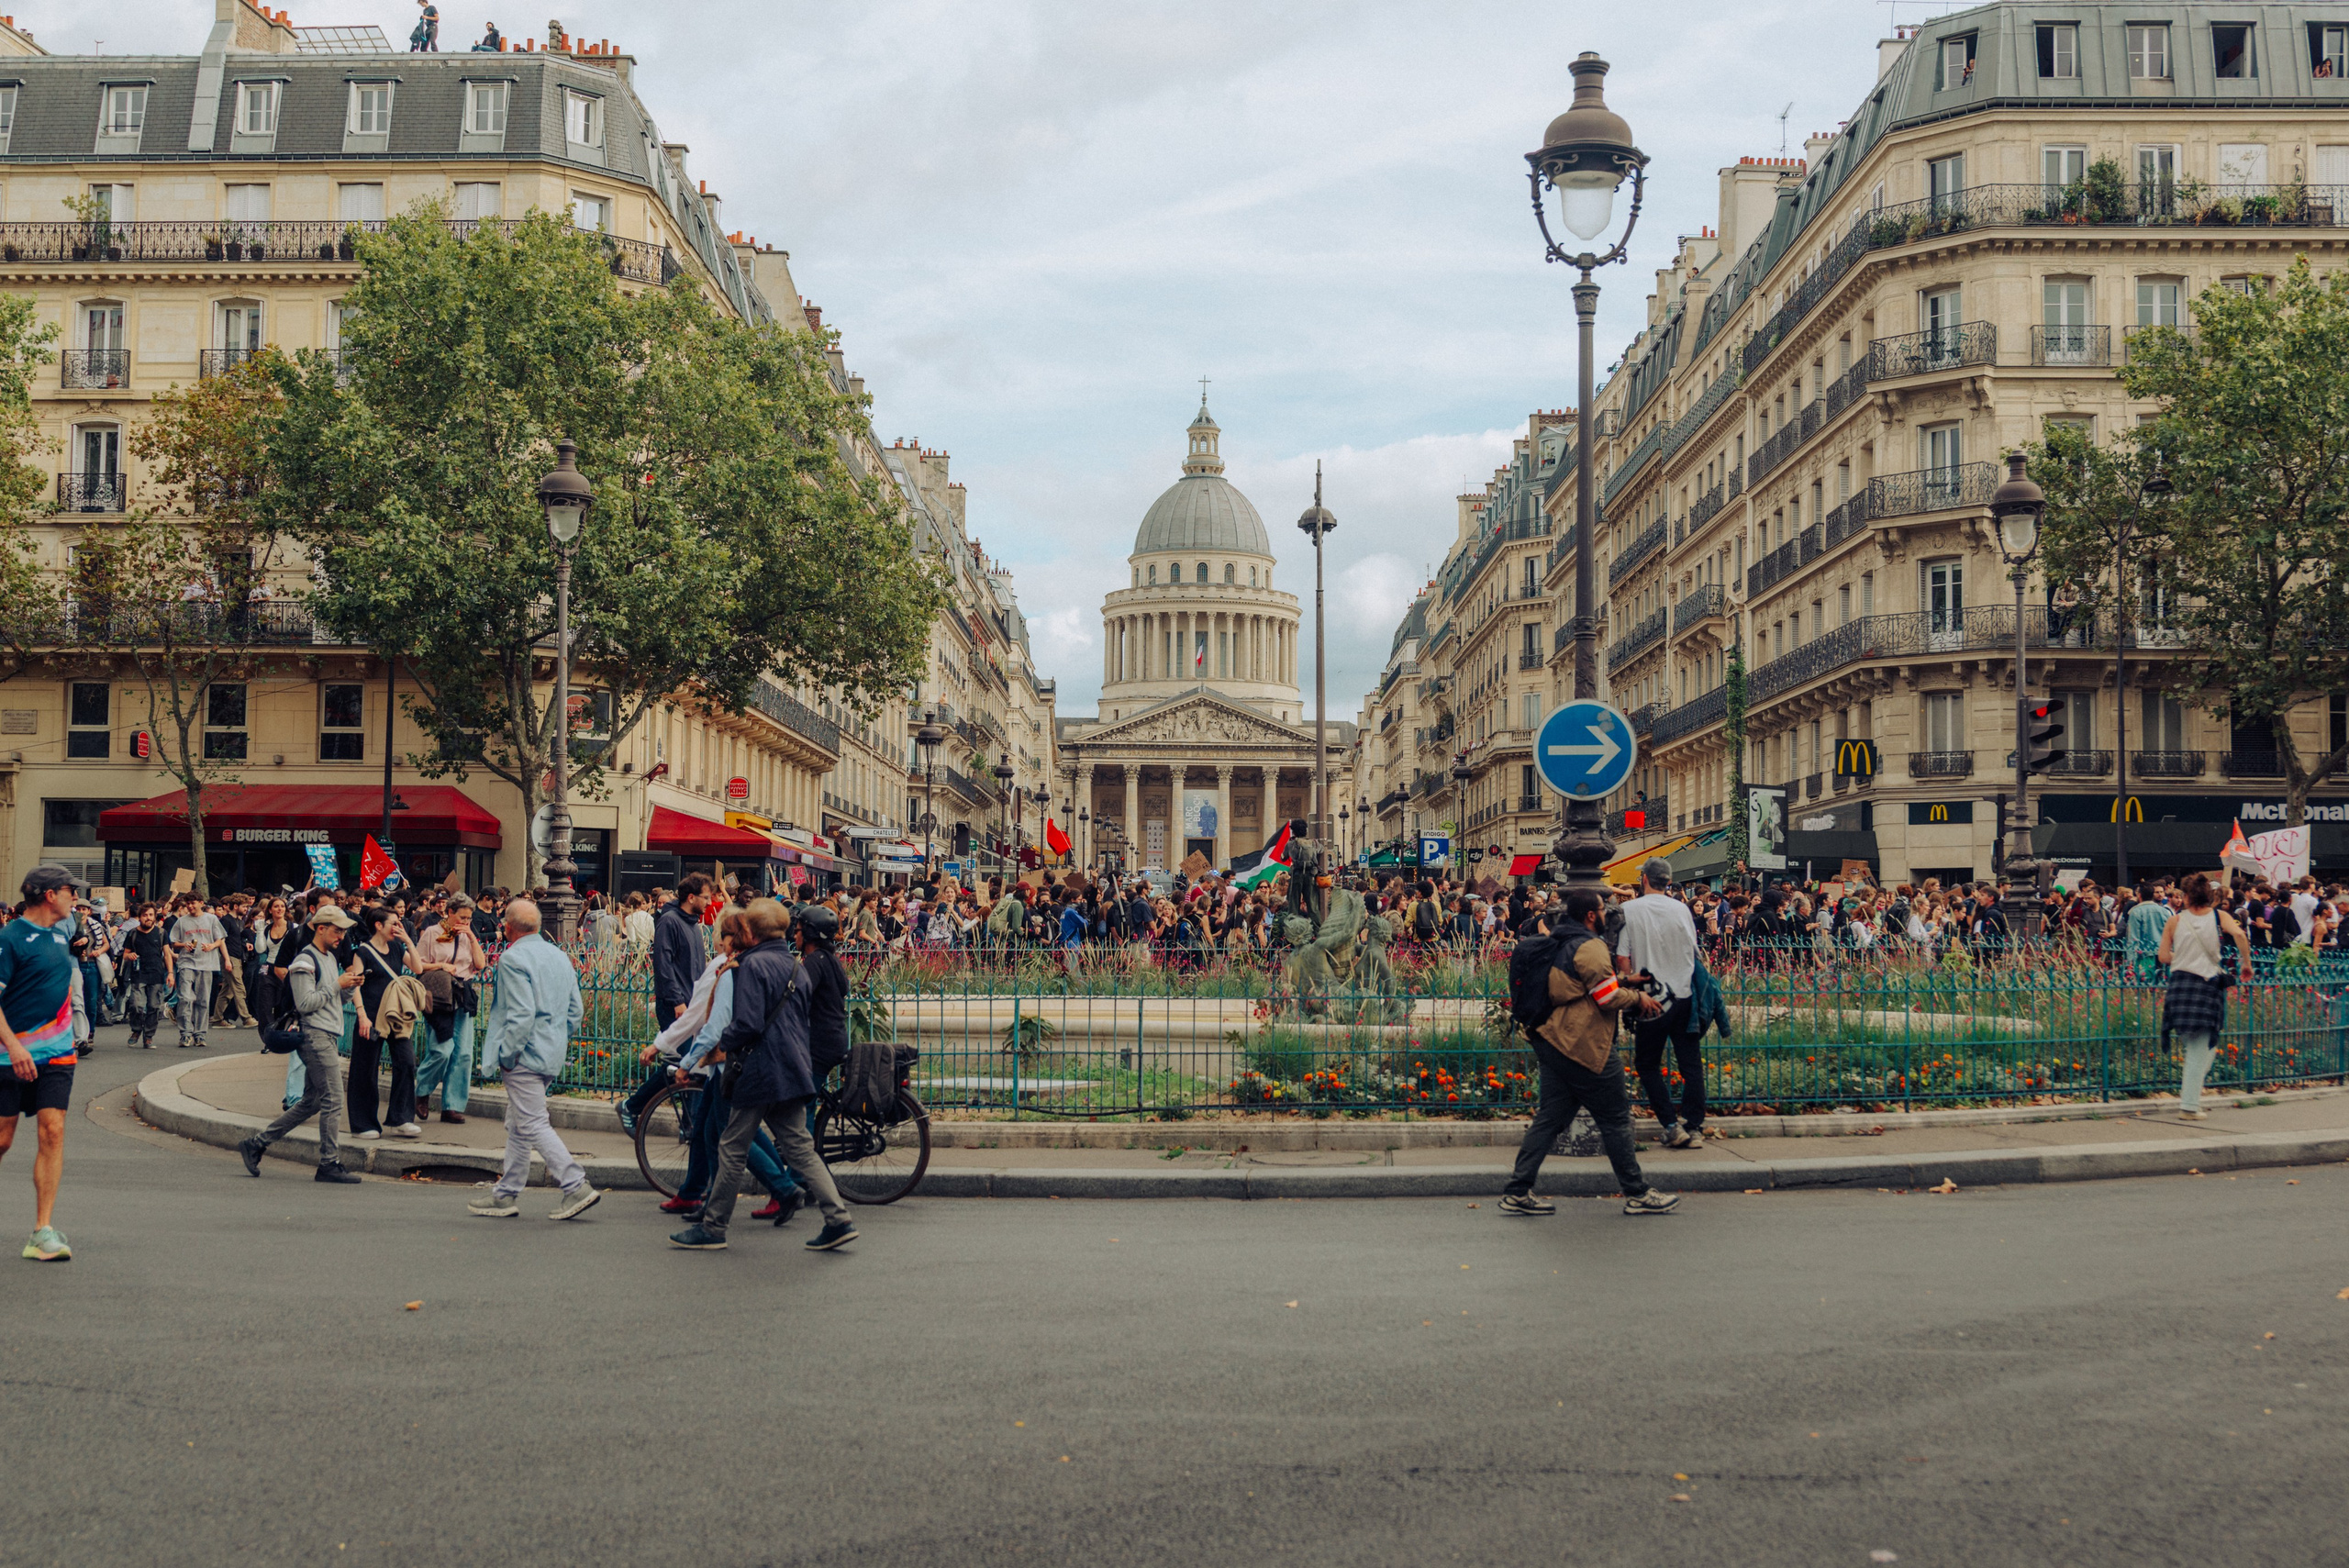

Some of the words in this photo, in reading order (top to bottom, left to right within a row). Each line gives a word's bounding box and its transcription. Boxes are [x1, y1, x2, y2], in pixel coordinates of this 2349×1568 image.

[1185, 806, 1193, 829] MARC
[236, 829, 291, 842] BURGER
[294, 829, 329, 842] KING
[1520, 827, 1545, 835] BARNES
[1424, 840, 1439, 859] P
